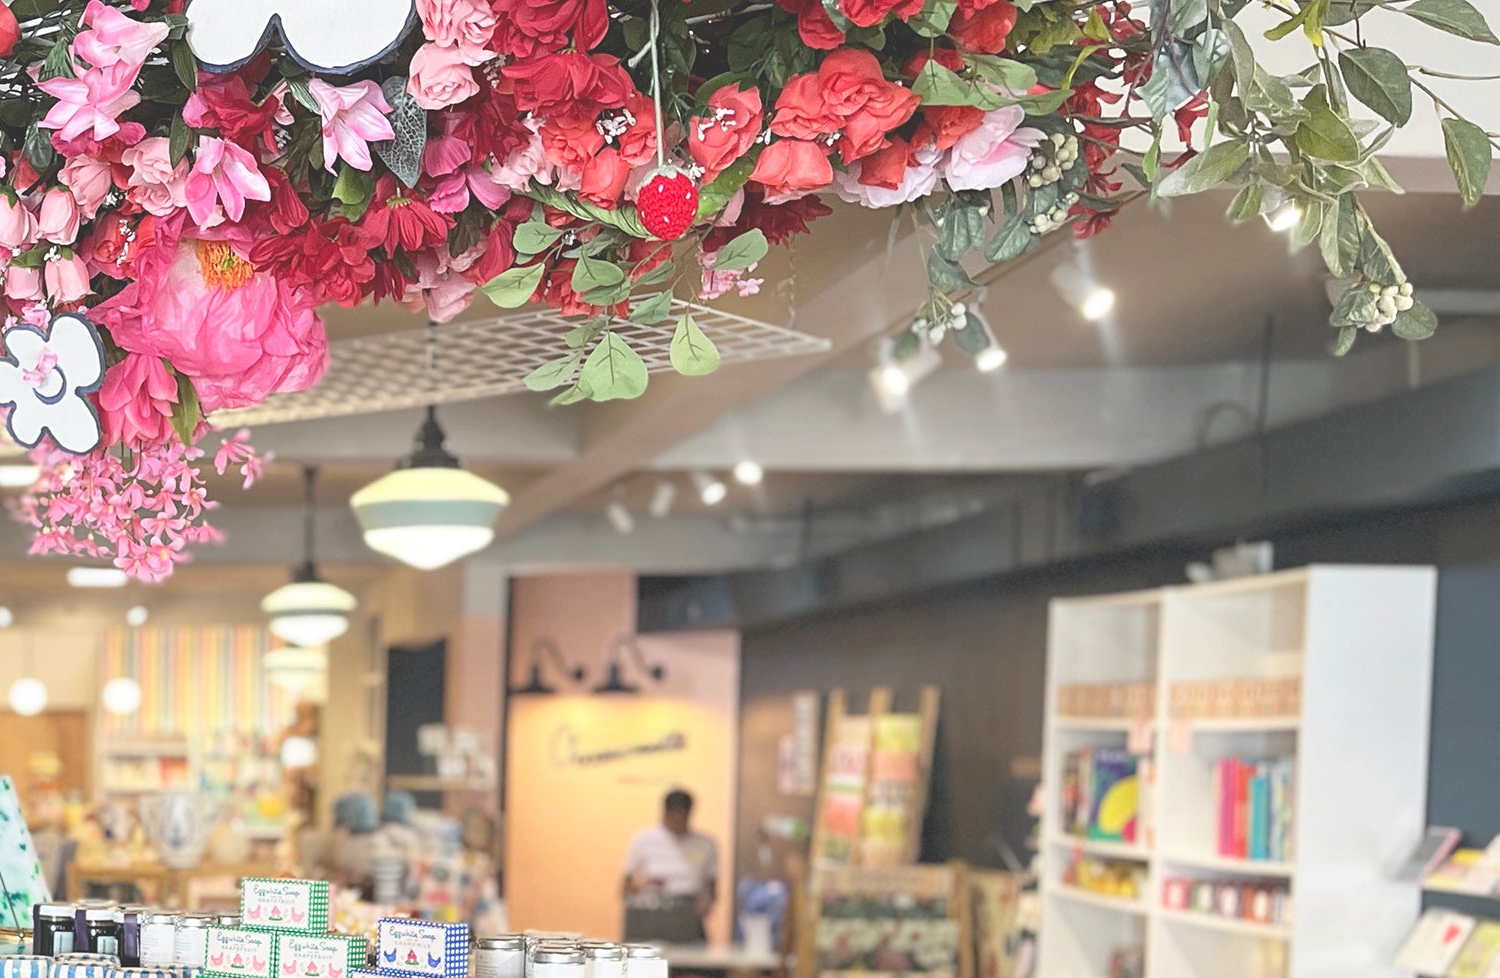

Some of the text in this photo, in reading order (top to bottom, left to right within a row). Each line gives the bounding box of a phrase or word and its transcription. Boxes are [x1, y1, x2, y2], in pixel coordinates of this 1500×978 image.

[282, 886, 300, 897] Soap
[245, 935, 262, 947] Soap
[418, 929, 436, 941] Soap
[319, 941, 338, 953] Soap
